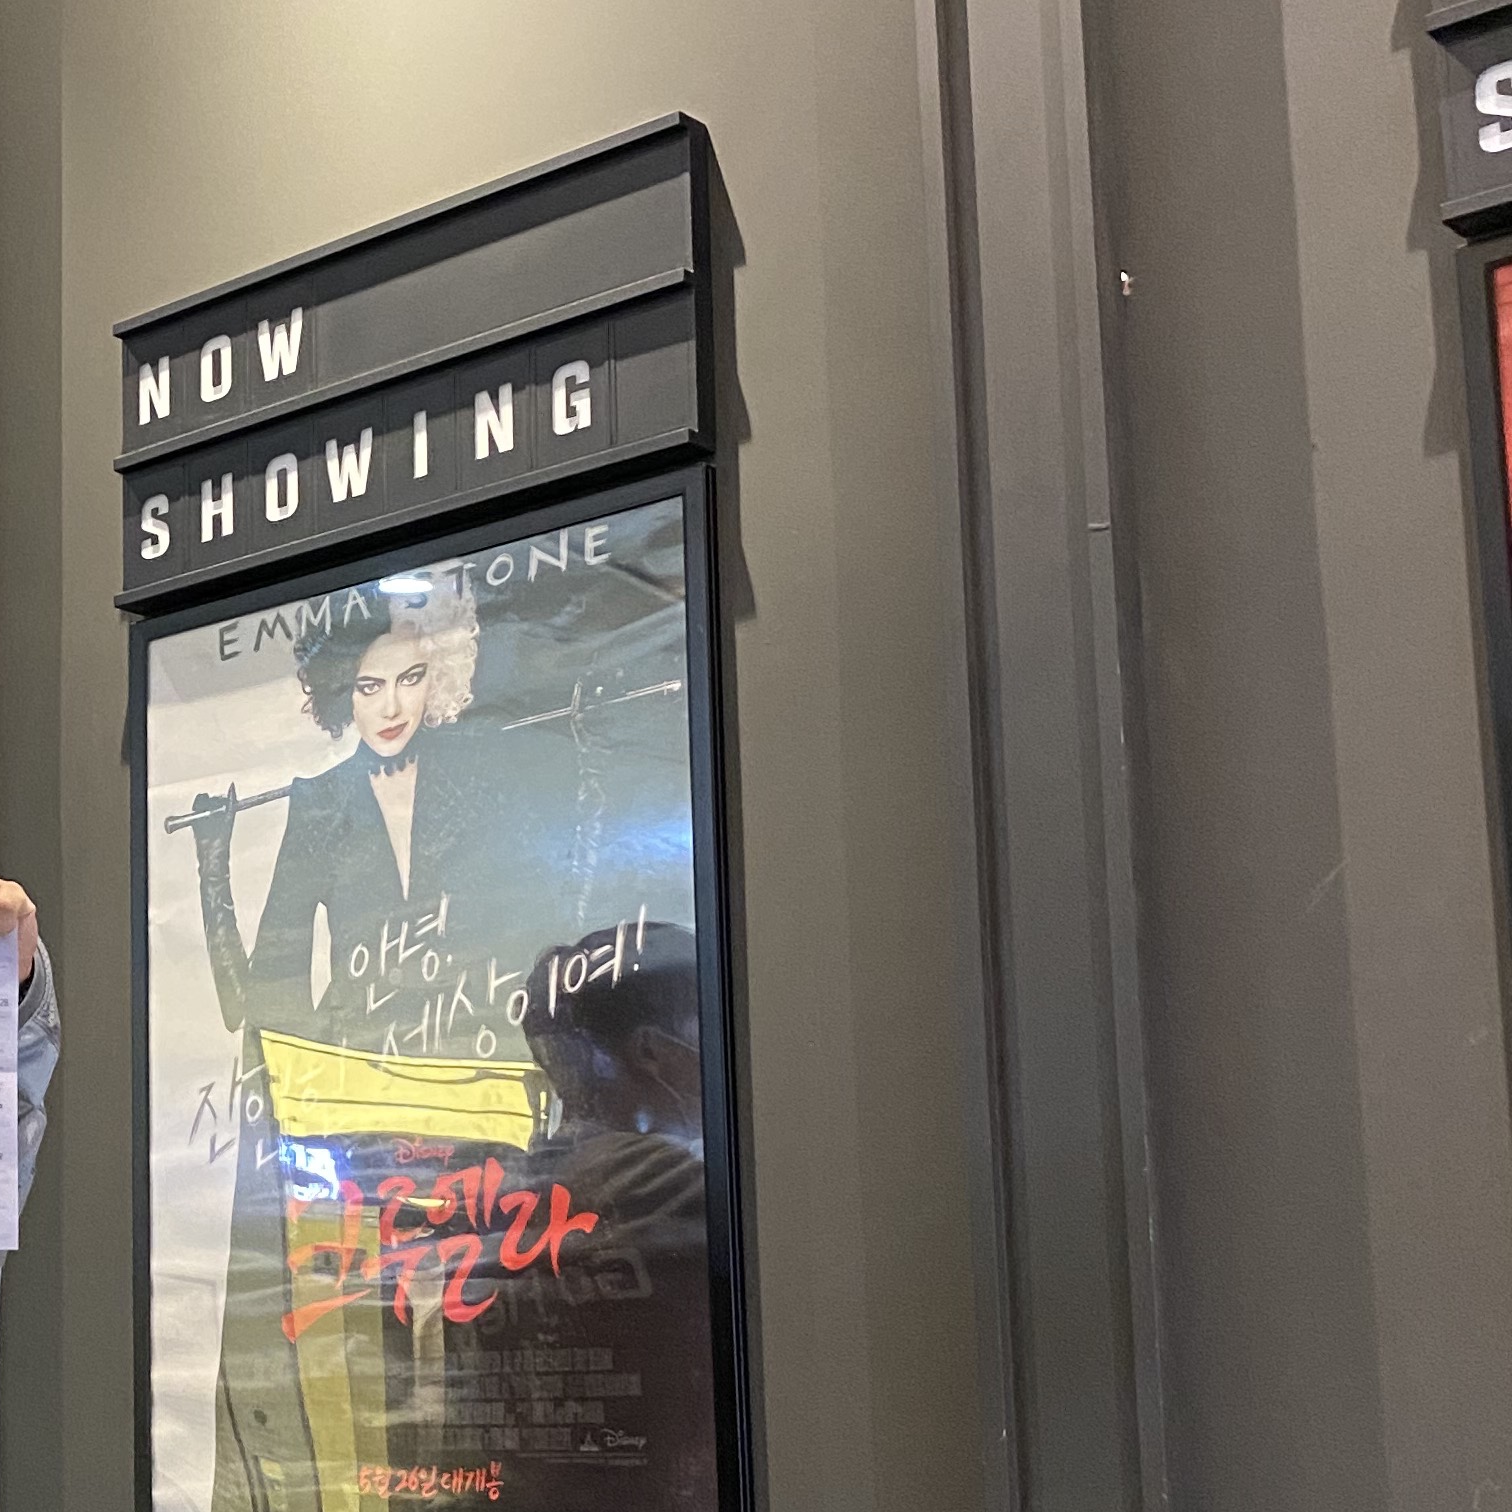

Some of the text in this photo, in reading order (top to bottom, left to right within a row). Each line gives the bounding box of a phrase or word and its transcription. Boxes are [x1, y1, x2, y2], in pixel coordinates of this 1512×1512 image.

[138, 307, 303, 425] NOW
[141, 360, 591, 560] SHOWING
[218, 588, 372, 662] EMMA
[393, 1136, 455, 1168] Disney
[394, 1464, 437, 1498] 26일
[440, 1460, 505, 1501] 대개봉
